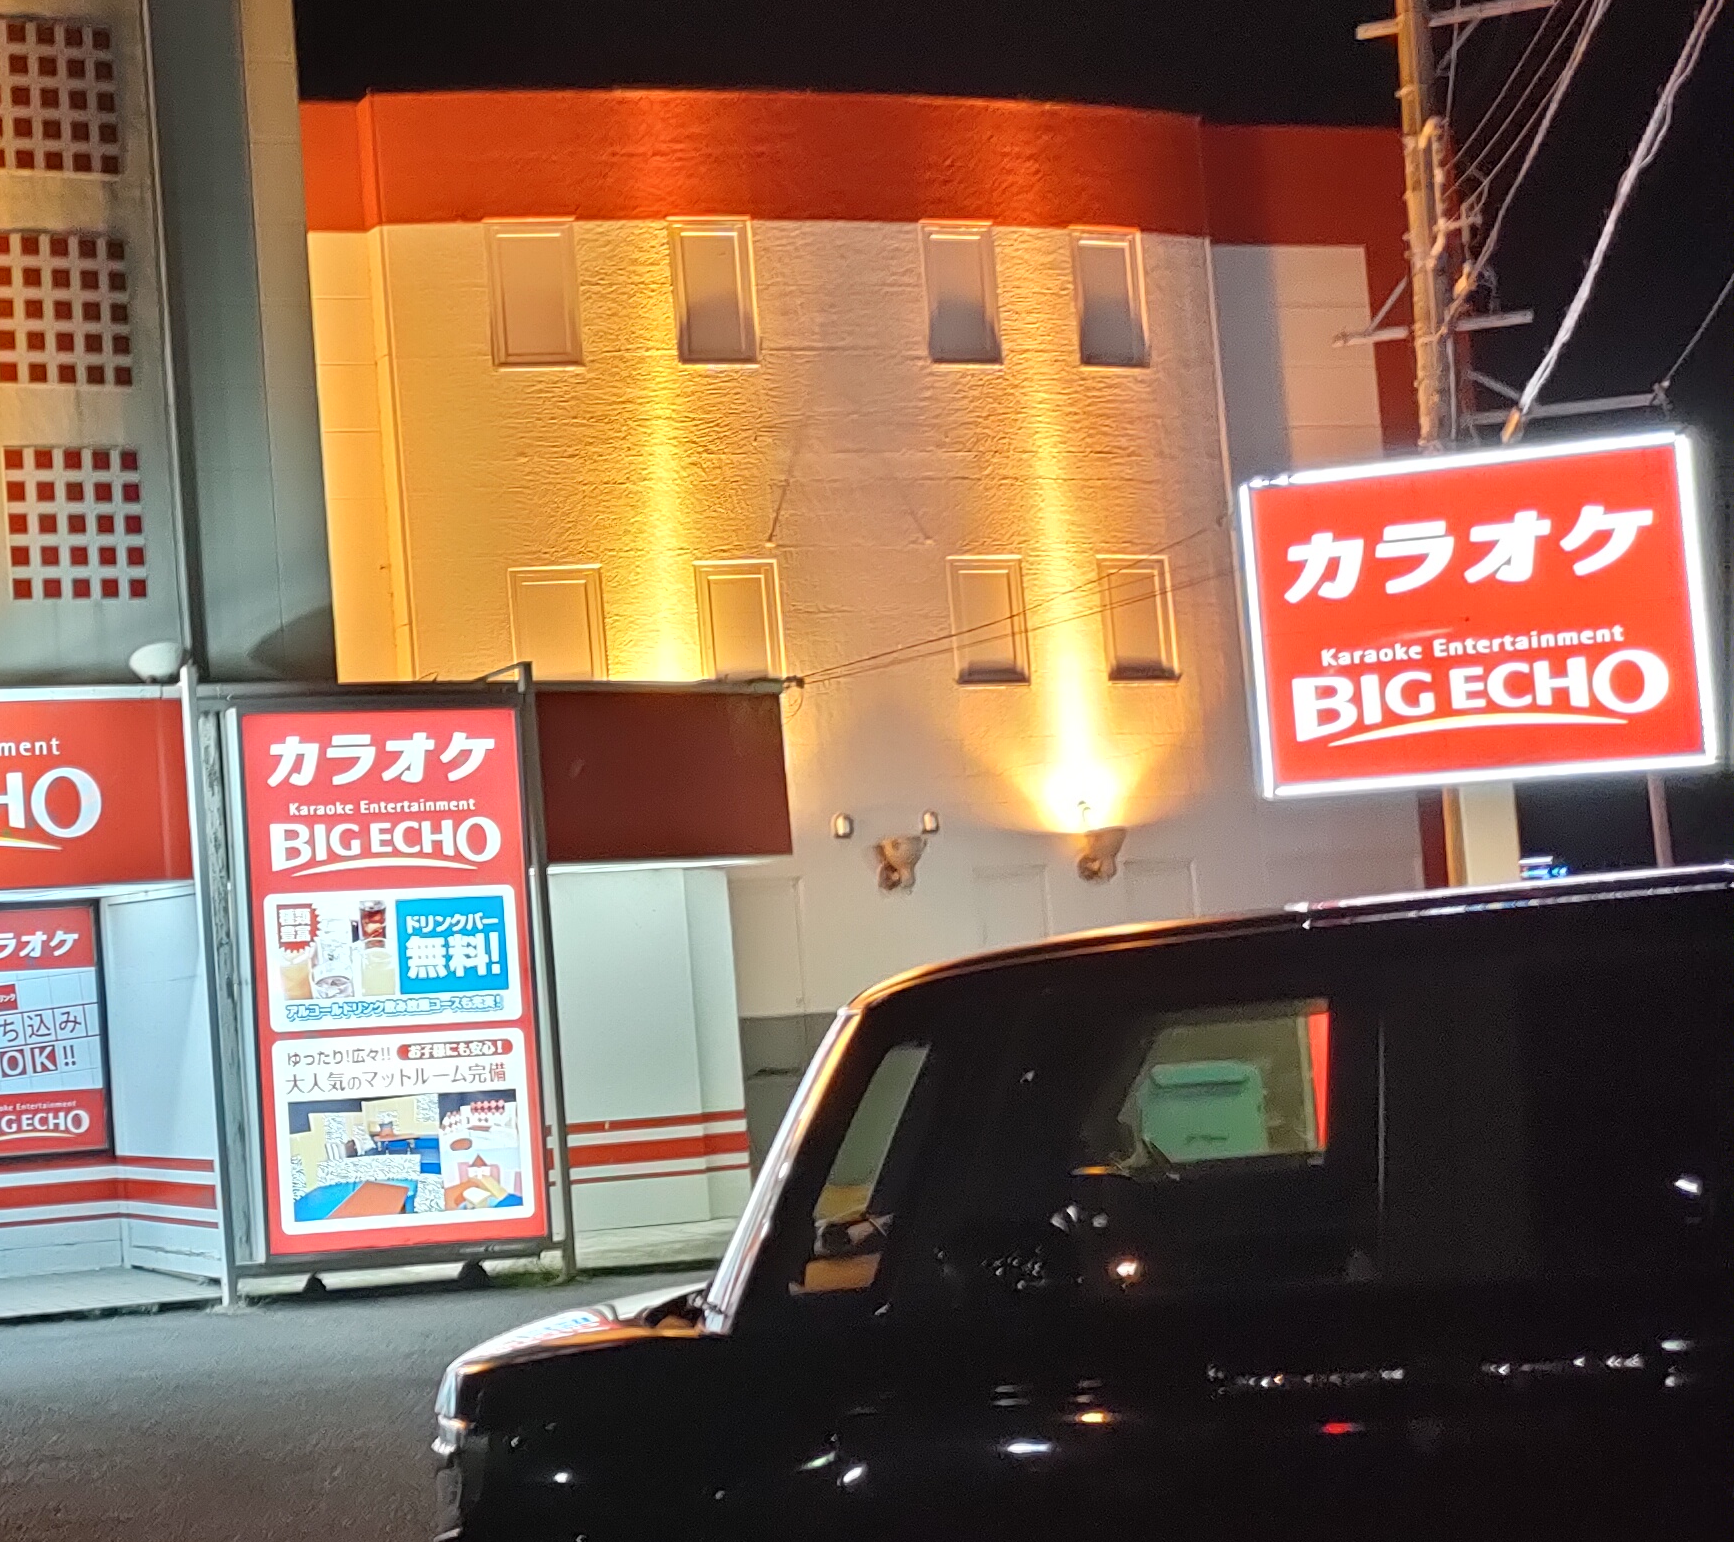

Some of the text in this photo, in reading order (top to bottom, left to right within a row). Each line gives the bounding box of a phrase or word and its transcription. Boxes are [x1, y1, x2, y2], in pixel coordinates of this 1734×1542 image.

[1284, 505, 1654, 605] カラオケ
[1320, 625, 1624, 667] Karaoke Entertainment
[1291, 649, 1670, 743] BIG ECHO
[267, 731, 496, 788] カラオケ
[288, 798, 476, 817] Karaoke Entertainment
[269, 816, 502, 872] BIG ECHO
[406, 912, 499, 934] ドリンクバー
[286, 1062, 507, 1094] 大人気のマットルーム完備
[16, 1100, 77, 1111] Entertainment
[21, 1110, 91, 1134] ECHO
